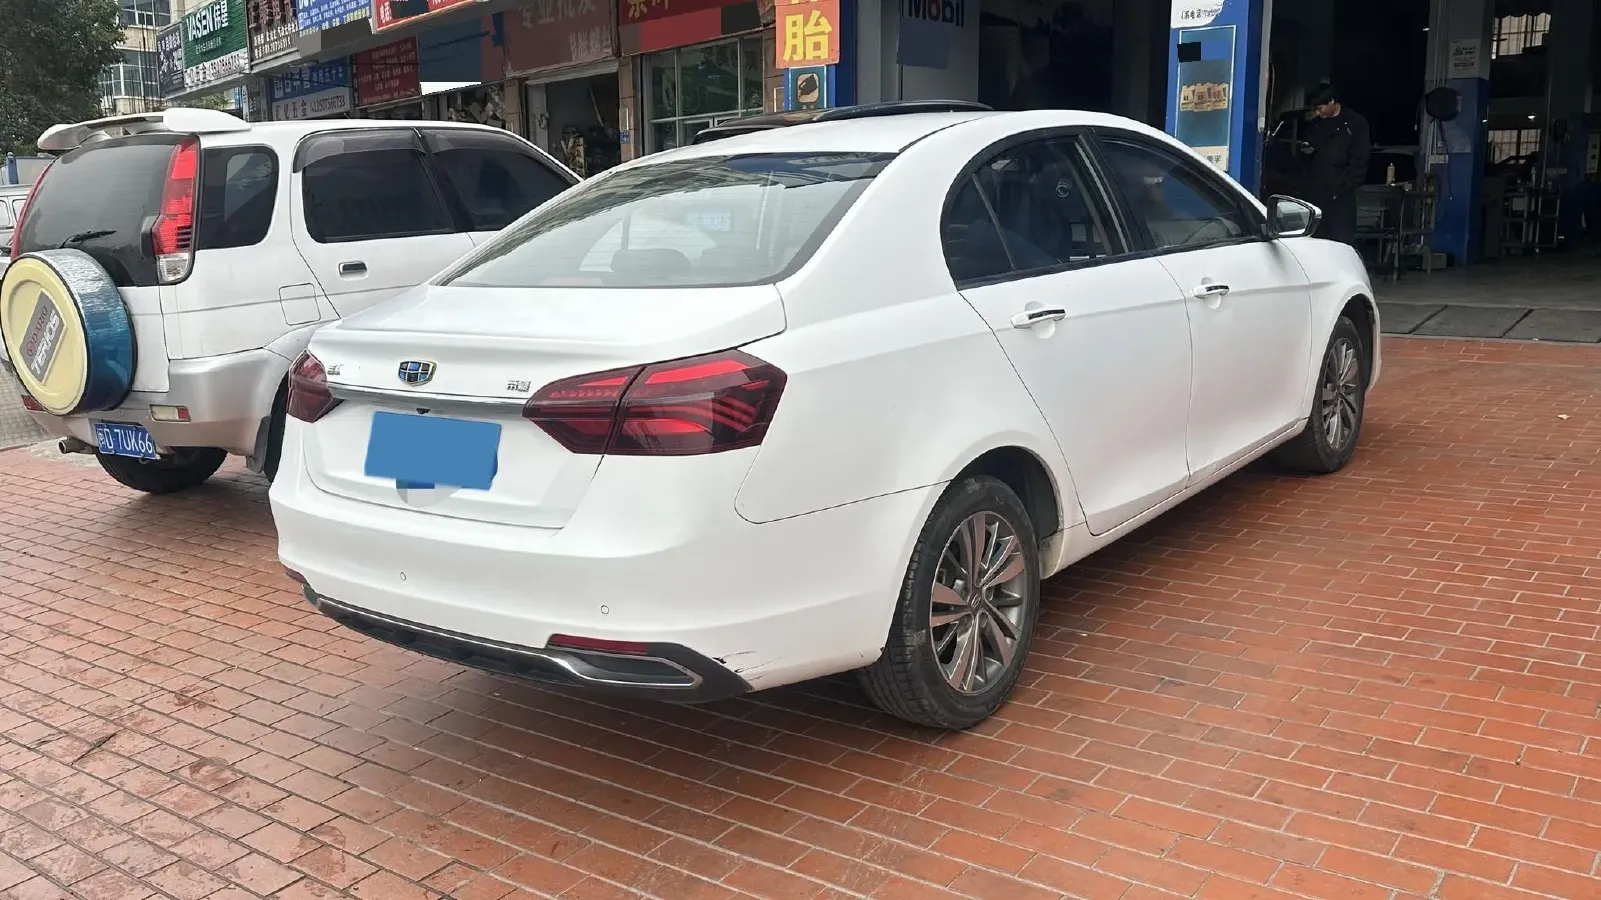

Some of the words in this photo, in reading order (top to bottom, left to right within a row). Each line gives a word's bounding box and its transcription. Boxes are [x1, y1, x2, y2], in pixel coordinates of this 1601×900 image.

[186, 6, 213, 41] VASEN
[213, 0, 228, 31] 伟星
[908, 0, 965, 28] Mobil
[783, 9, 833, 62] 胎
